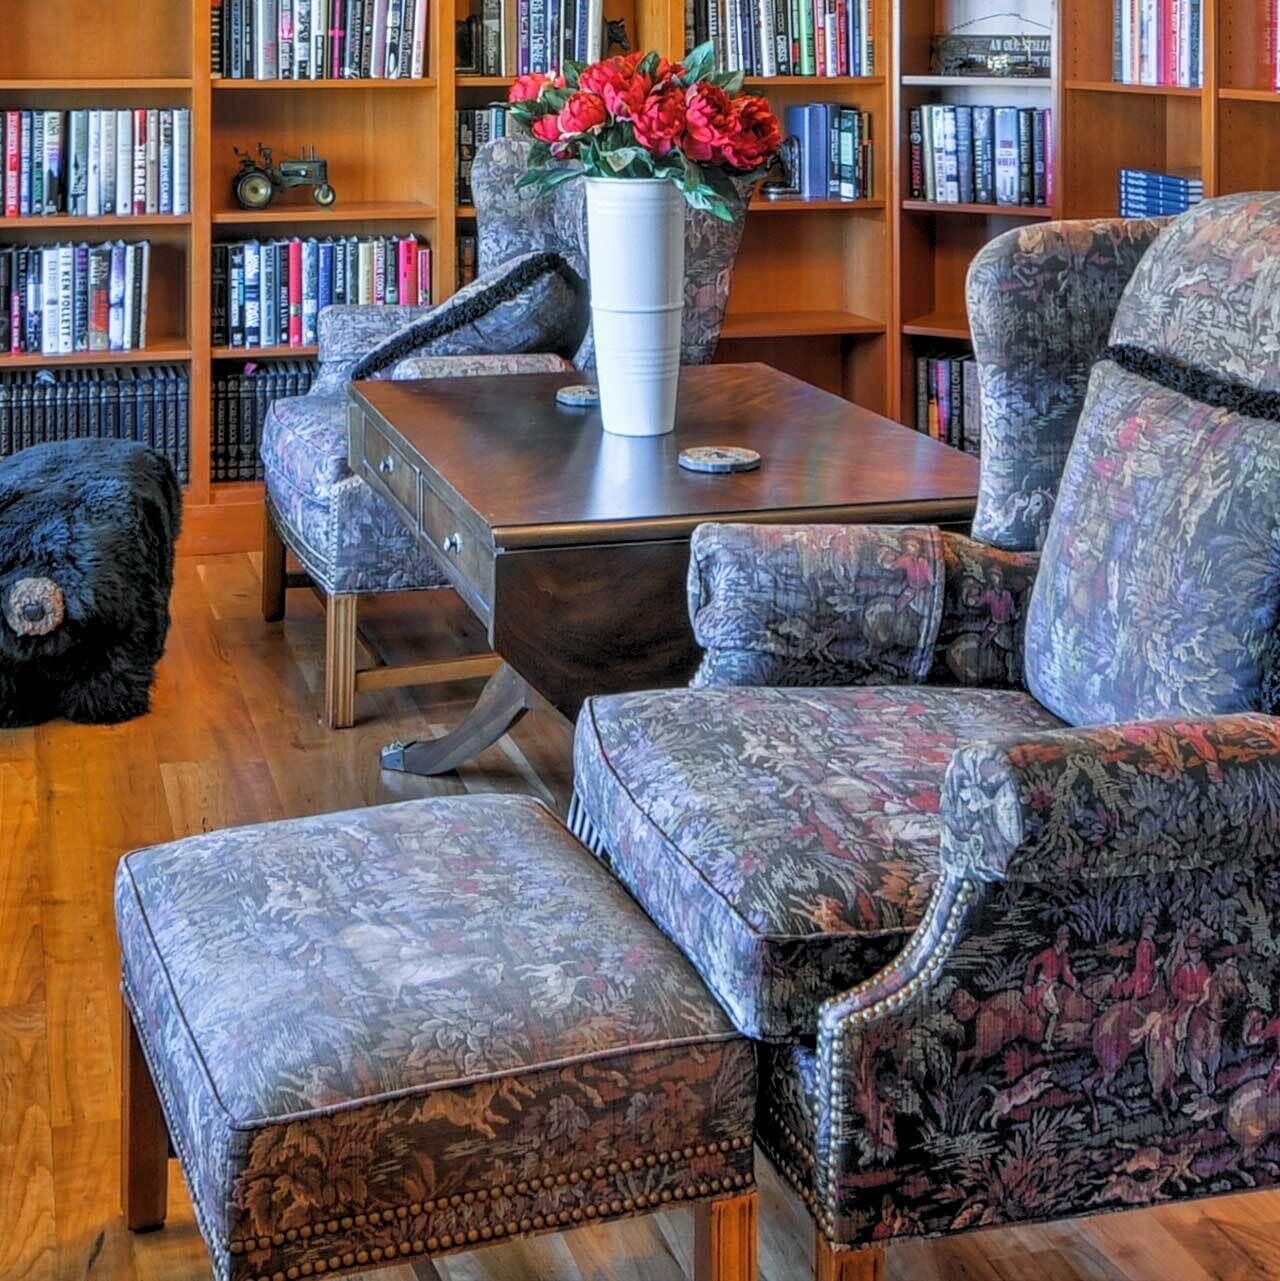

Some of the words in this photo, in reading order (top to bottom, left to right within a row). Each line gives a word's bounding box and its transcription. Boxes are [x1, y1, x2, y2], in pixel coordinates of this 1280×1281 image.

[776, 13, 787, 32] COOK
[776, 35, 787, 62] CRISIS
[133, 145, 146, 166] THE
[975, 140, 983, 165] WALLY
[133, 168, 146, 202] RACE
[975, 167, 983, 189] LAMB
[266, 248, 274, 268] DALE
[375, 247, 385, 272] STEPHEN
[61, 271, 72, 288] KEN
[77, 272, 88, 292] KEN
[266, 271, 274, 300] BROWN
[375, 274, 385, 298] COONTS
[61, 294, 72, 336] FOLLETT
[77, 295, 88, 336] FOLLETT
[230, 400, 238, 424] WORLD
[230, 425, 238, 443] BOOK
